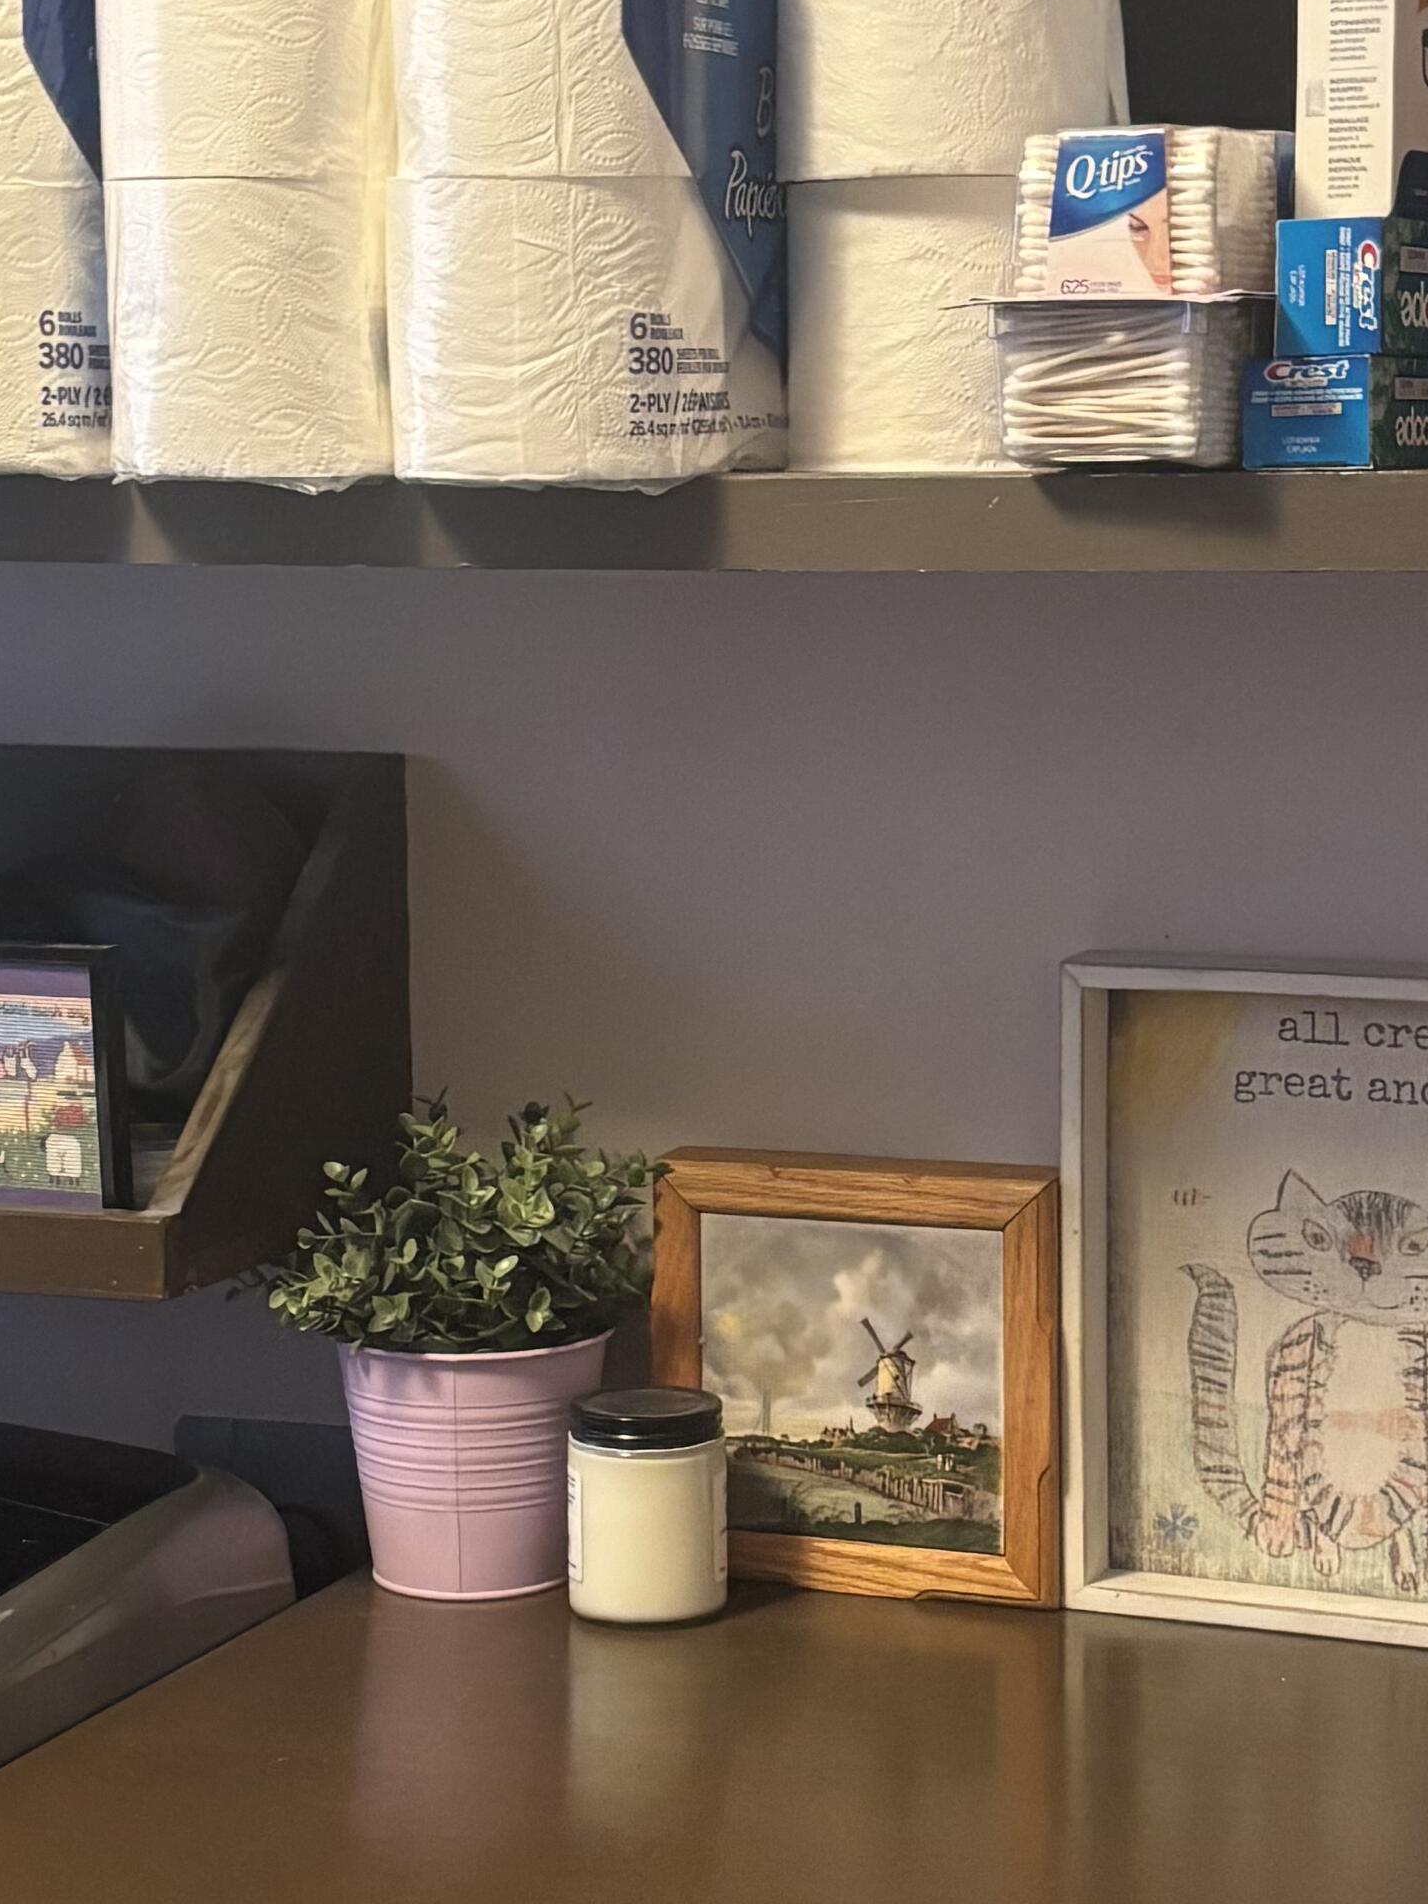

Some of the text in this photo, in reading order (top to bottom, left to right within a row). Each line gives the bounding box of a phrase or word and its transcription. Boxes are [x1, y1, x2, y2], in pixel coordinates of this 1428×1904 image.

[1358, 240, 1380, 331] Crest
[39, 310, 56, 336] 6
[630, 313, 648, 340] 6
[38, 343, 84, 370] 380
[628, 347, 673, 375] 380
[1263, 359, 1350, 383] Crest
[41, 386, 81, 407] 2-PLY
[630, 392, 671, 414] 2-PLY
[1278, 1010, 1350, 1046] all
[1233, 1065, 1353, 1105] great
